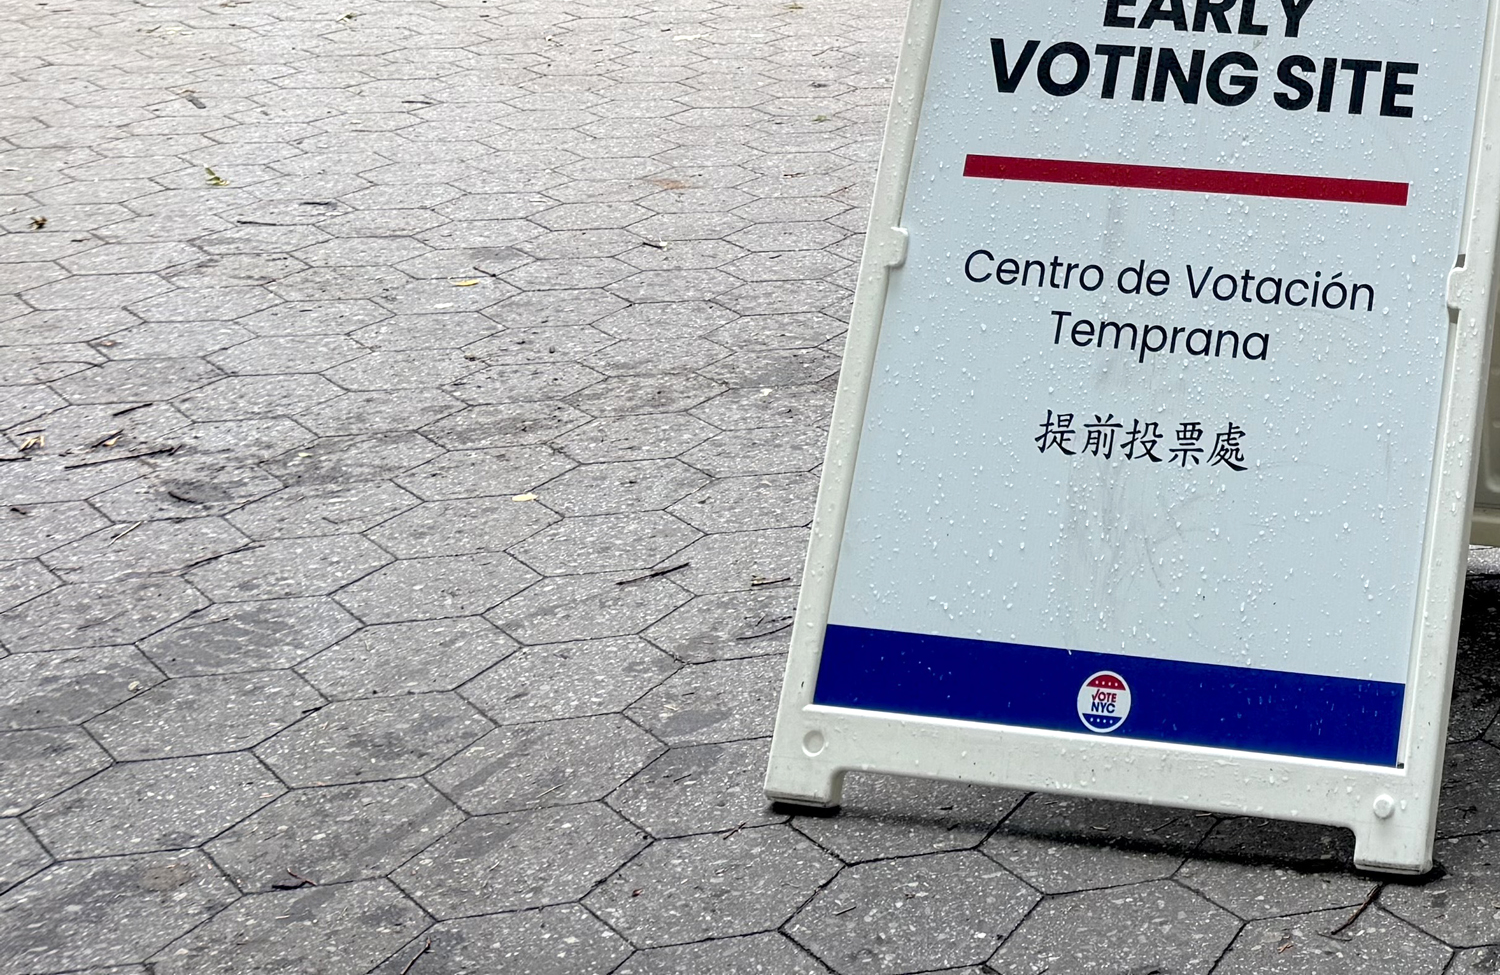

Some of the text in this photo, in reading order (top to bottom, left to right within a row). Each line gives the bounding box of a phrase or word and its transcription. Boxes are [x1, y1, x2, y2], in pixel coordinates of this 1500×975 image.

[990, 37, 1419, 118] VOTING SITE
[964, 249, 1376, 312] Centro de Votación
[1050, 310, 1270, 363] Temprana
[1034, 409, 1249, 472] 提前投票處
[1090, 700, 1116, 714] NYC
[1091, 688, 1118, 703] VOTE
